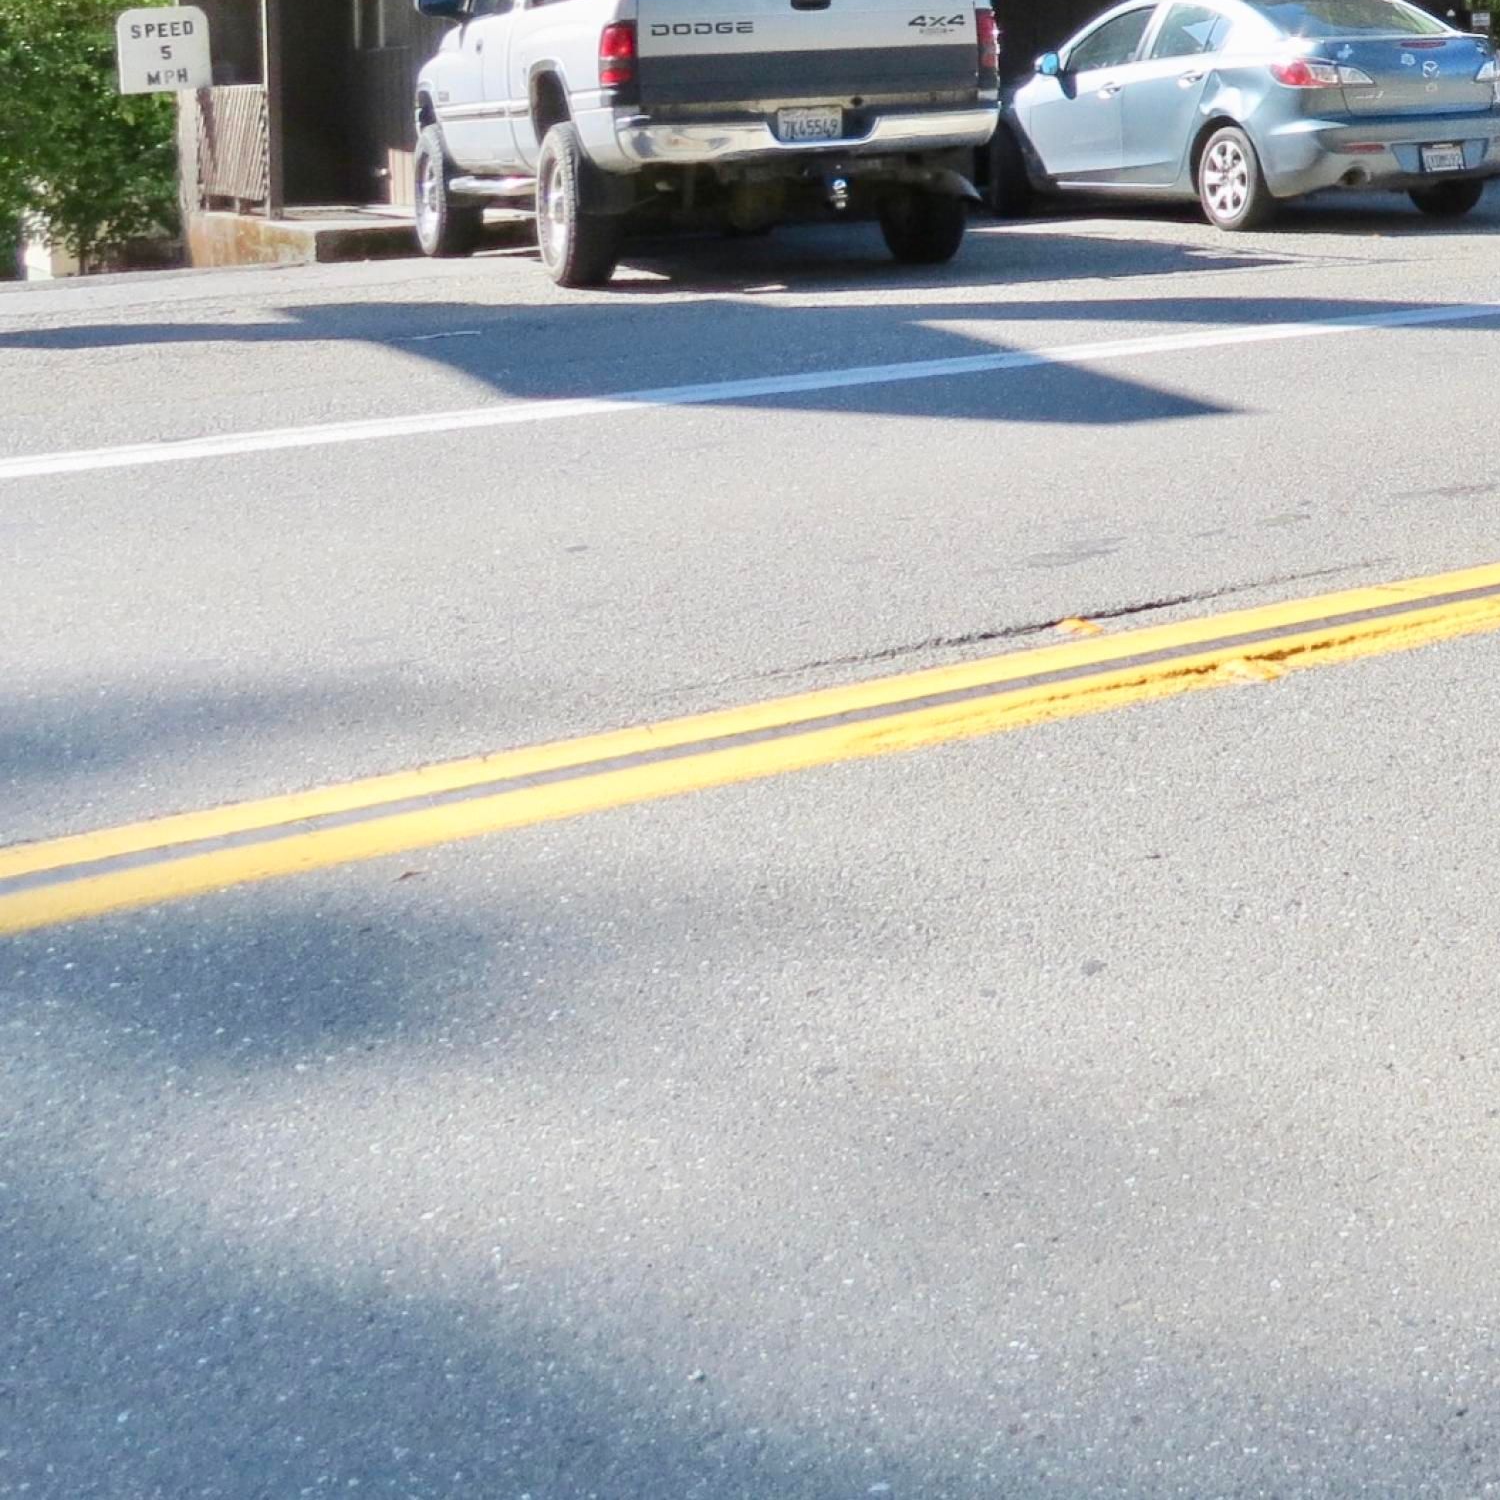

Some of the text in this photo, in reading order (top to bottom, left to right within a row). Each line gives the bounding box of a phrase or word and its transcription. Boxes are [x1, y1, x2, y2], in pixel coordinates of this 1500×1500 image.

[130, 20, 194, 40] SPEED
[651, 21, 754, 37] DODGE
[159, 44, 173, 60] 5
[147, 67, 189, 85] MPH
